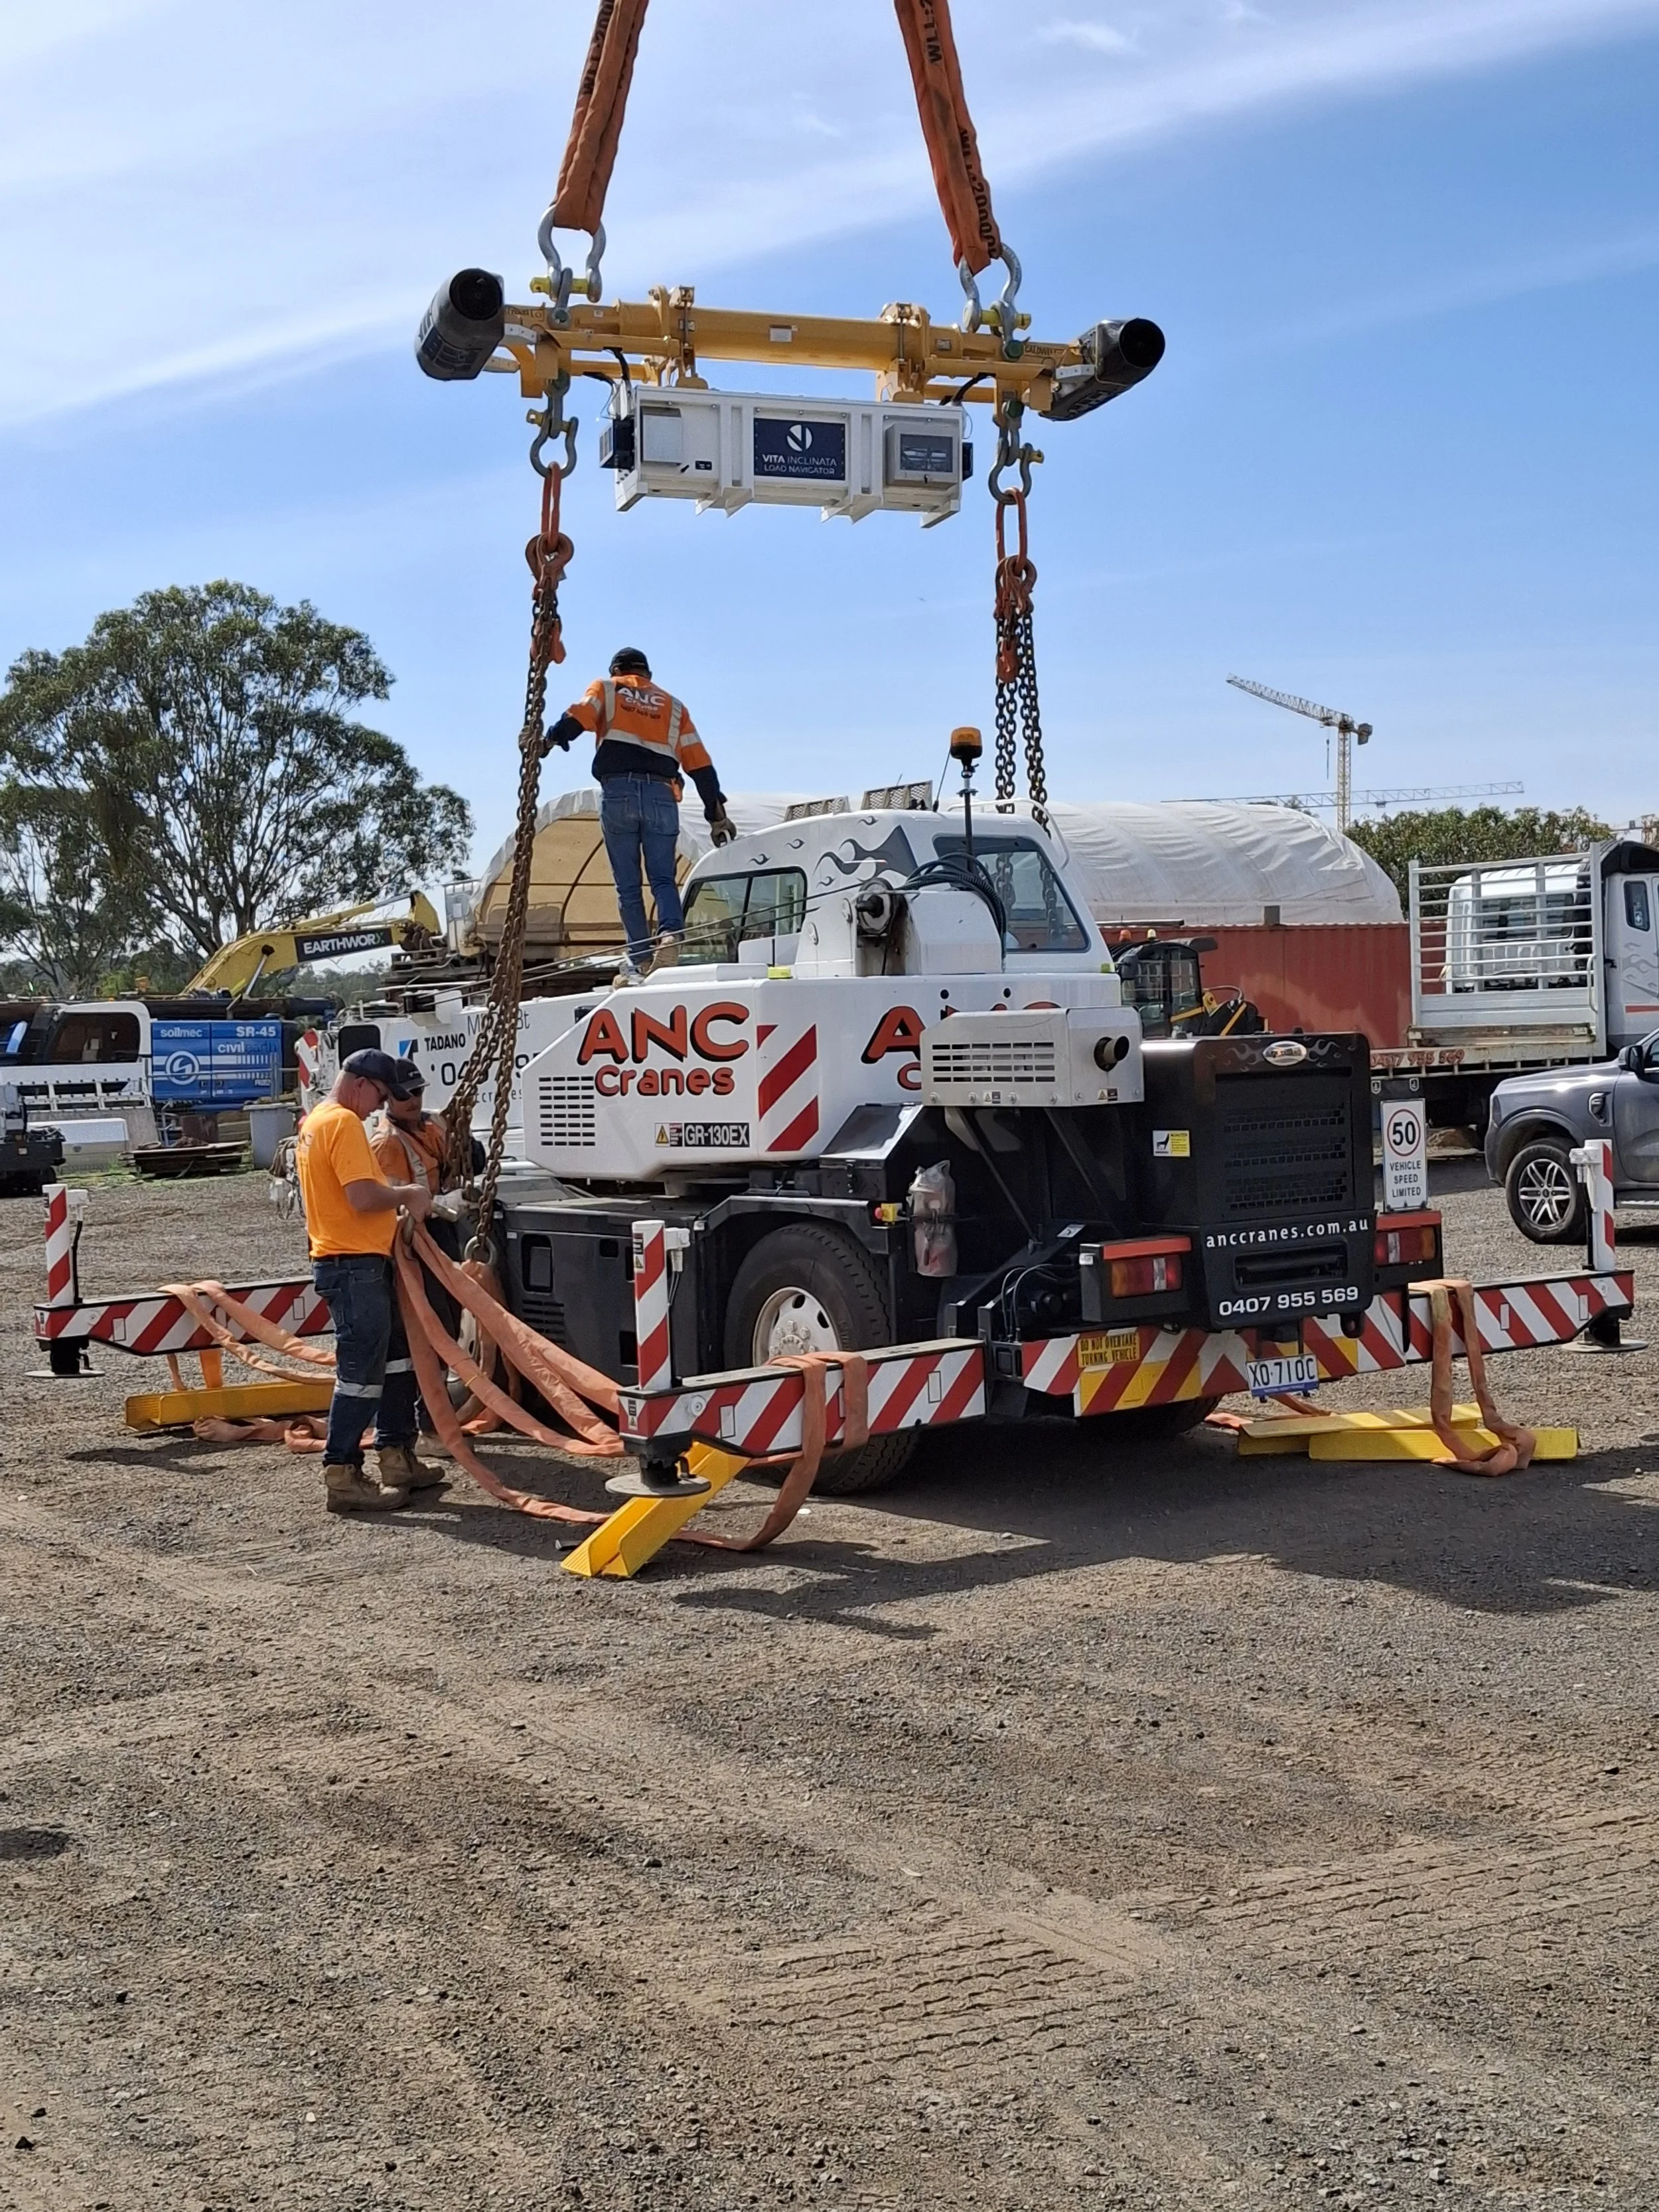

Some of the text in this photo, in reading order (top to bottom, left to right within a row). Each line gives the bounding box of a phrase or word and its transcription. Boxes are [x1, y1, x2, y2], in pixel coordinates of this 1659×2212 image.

[762, 454, 837, 466] VITA INCLINATA
[764, 464, 835, 475] LOAD NAVIGATOR
[617, 687, 666, 707] ANC
[303, 932, 385, 955] EARTHWORX
[160, 1027, 203, 1038] soilmec
[236, 1025, 277, 1038] SR-45
[577, 1001, 751, 1066] ANC
[424, 1032, 466, 1052] TADANO
[595, 1064, 735, 1097] Cranes
[685, 1124, 749, 1146] GR-130EX
[1392, 1120, 1417, 1146] 50
[1390, 1160, 1421, 1172] VEHICLE
[1394, 1173, 1418, 1185] SPEED
[1392, 1186, 1421, 1198] LIMITED
[1206, 1218, 1369, 1248] anccranes.com.au
[1218, 1286, 1359, 1316] 0407 955 569
[1080, 1332, 1136, 1352] DO NOT OVERTAKE
[1081, 1347, 1137, 1365] TURNING VEHICLE
